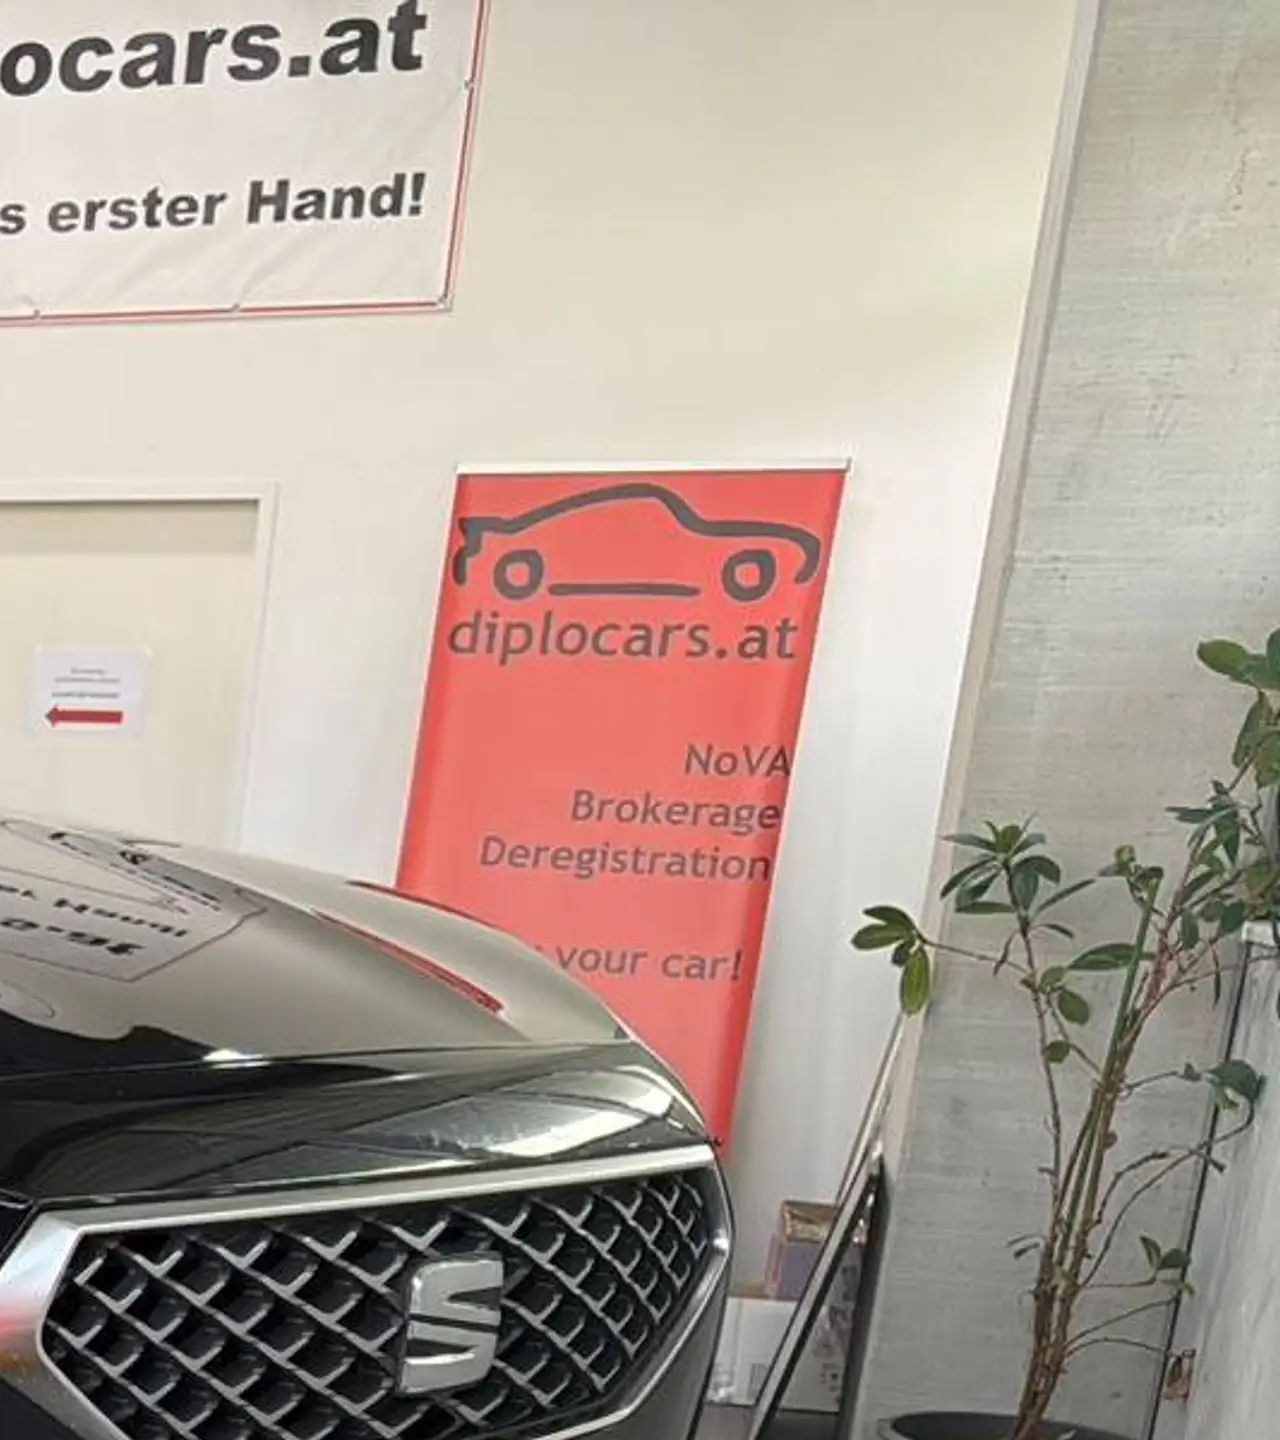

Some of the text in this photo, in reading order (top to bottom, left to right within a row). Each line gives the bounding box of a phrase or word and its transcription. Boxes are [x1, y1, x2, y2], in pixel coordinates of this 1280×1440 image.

[47, 188, 226, 234] erster
[247, 173, 427, 226] Hand!
[447, 610, 799, 667] diplocars.at
[684, 744, 792, 779] NoVA
[570, 791, 782, 835] Brokerage
[479, 836, 772, 882] Deregistration
[557, 945, 744, 982] your car!
